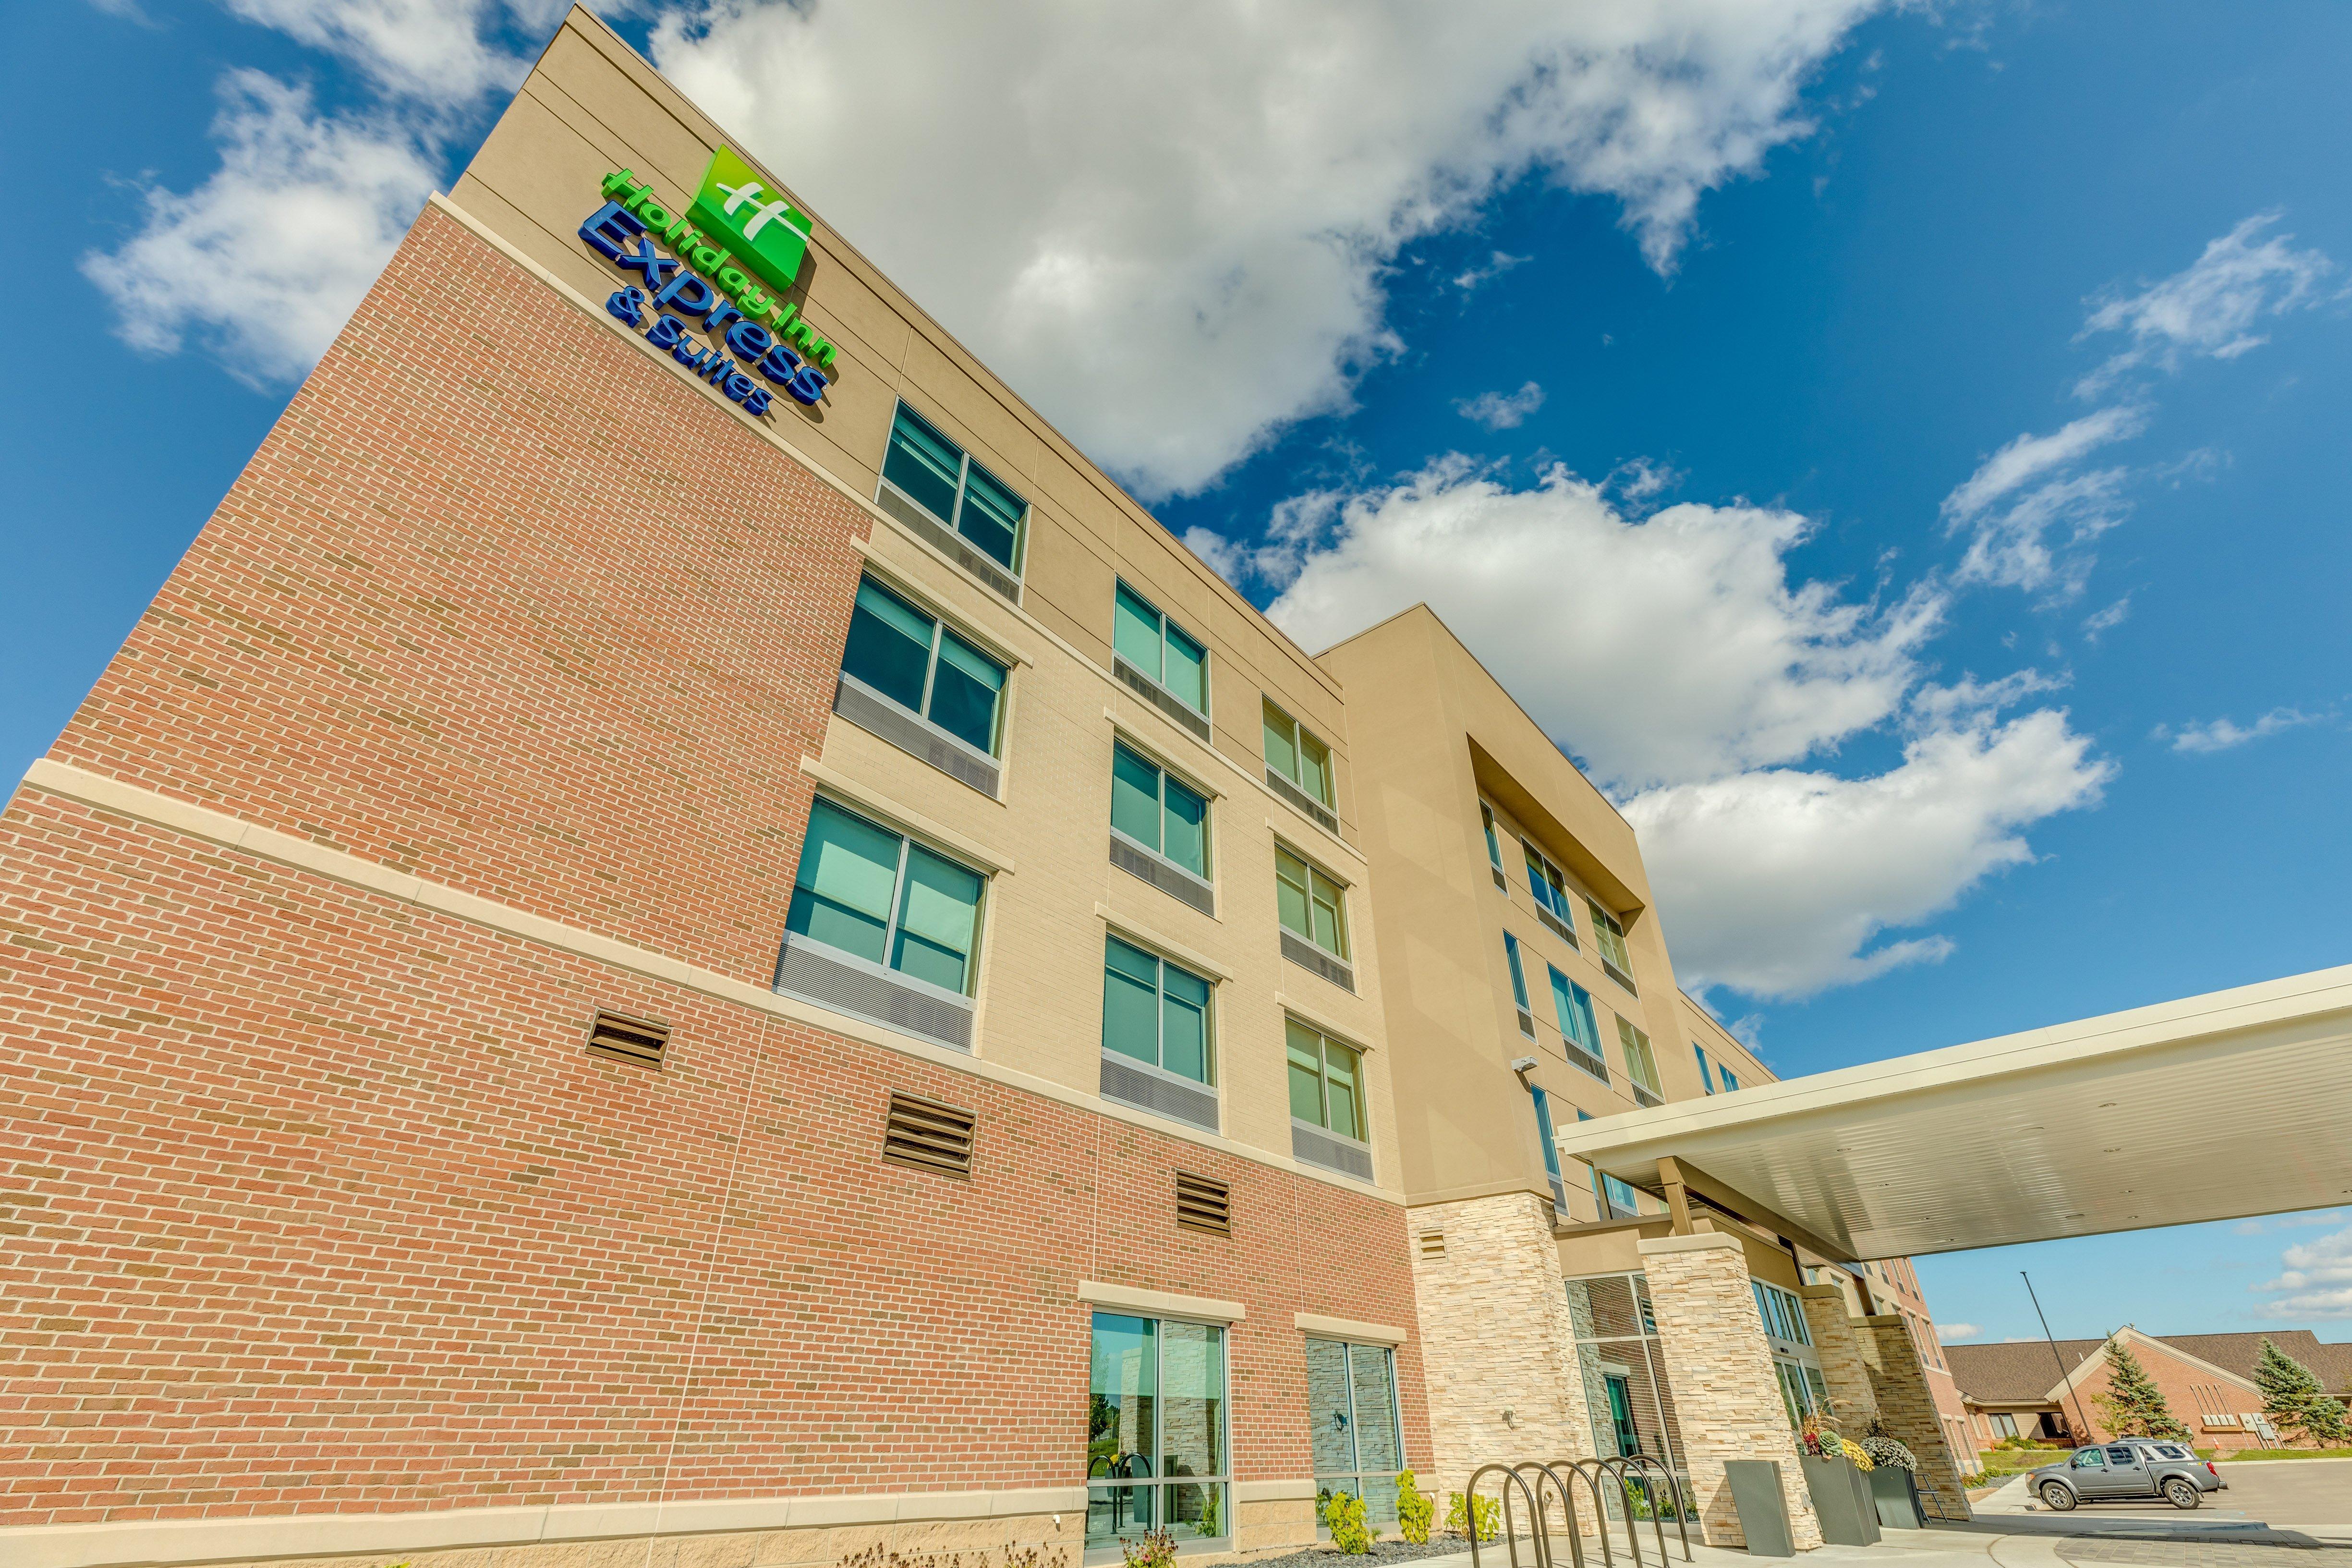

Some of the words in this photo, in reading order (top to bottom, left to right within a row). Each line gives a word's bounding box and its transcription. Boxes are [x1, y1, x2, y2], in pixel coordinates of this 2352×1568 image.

[578, 200, 829, 406] Express
[601, 168, 776, 320] Holiday
[771, 302, 837, 369] Inn
[606, 285, 645, 328] &
[645, 314, 774, 417] Suites
